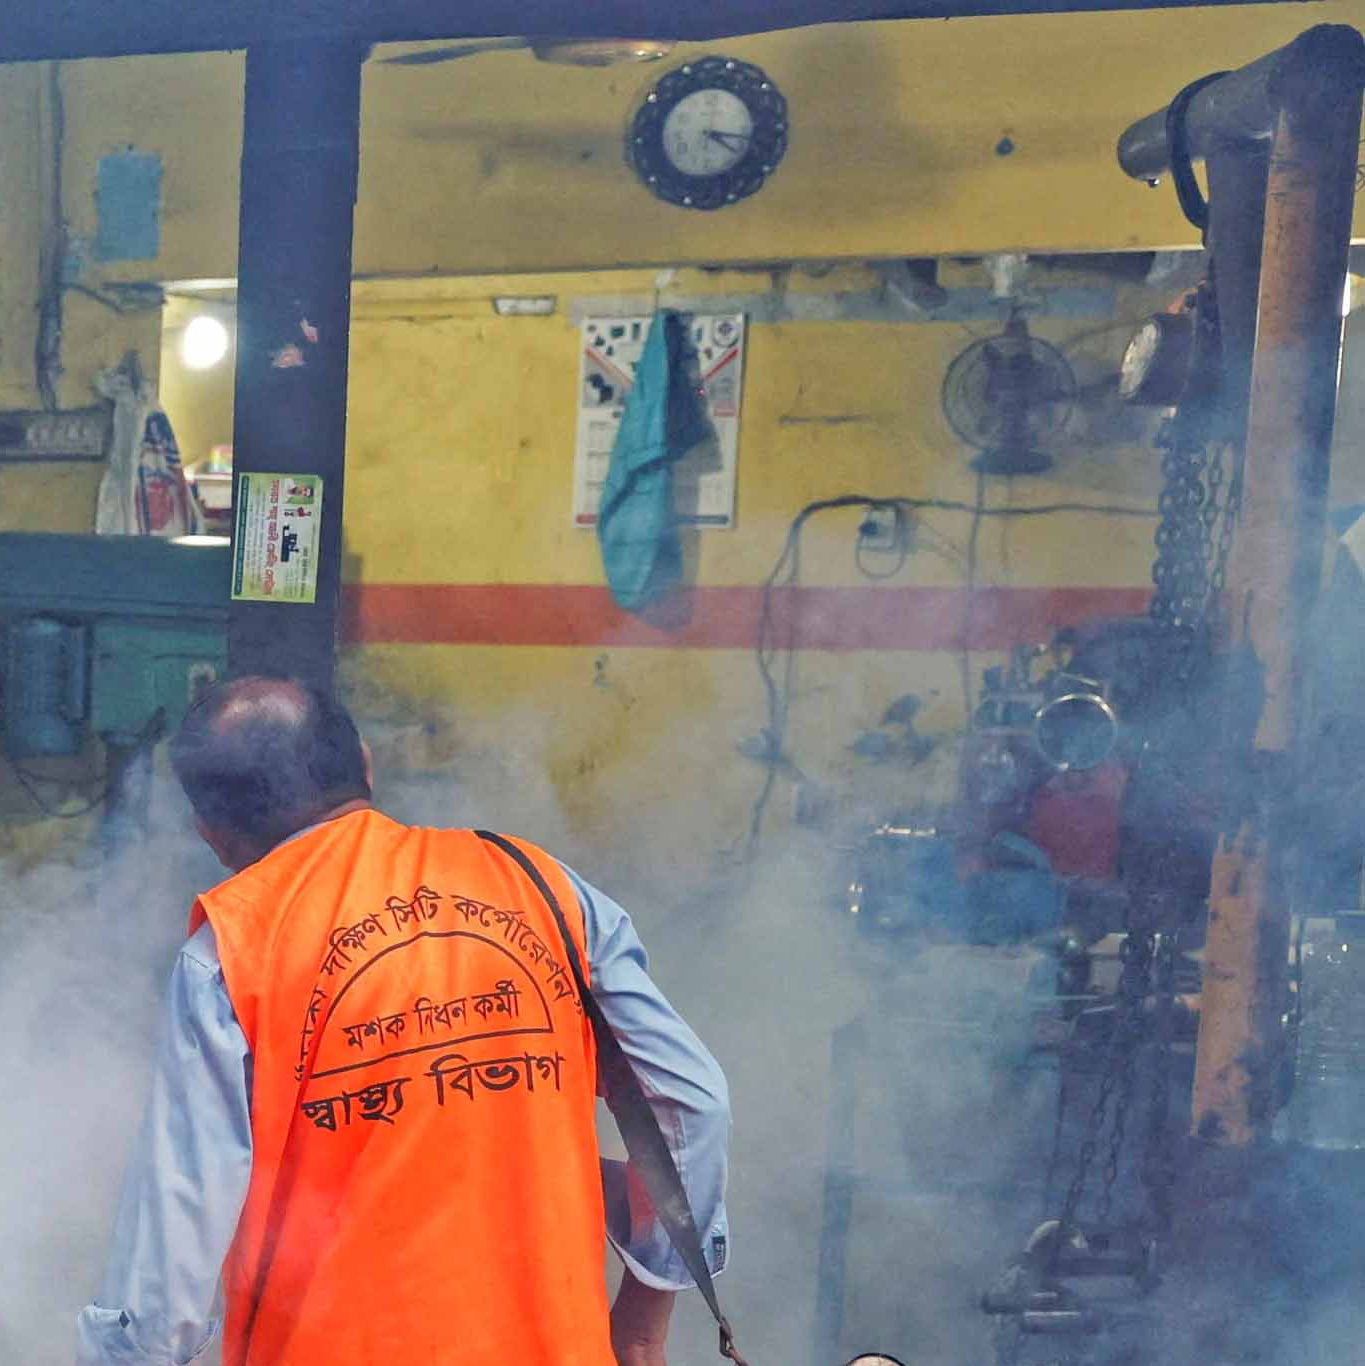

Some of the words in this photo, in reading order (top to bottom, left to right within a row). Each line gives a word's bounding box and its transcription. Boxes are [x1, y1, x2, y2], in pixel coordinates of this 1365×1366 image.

[321, 914, 387, 976] দক্ষিণ
[384, 886, 443, 932] সিটি
[342, 1013, 407, 1050] মশক
[412, 996, 467, 1035] নিধন
[471, 979, 523, 1021] কর্মী
[301, 1076, 414, 1132] স্বাস্থ্য
[424, 1052, 566, 1106] বিভাগ
